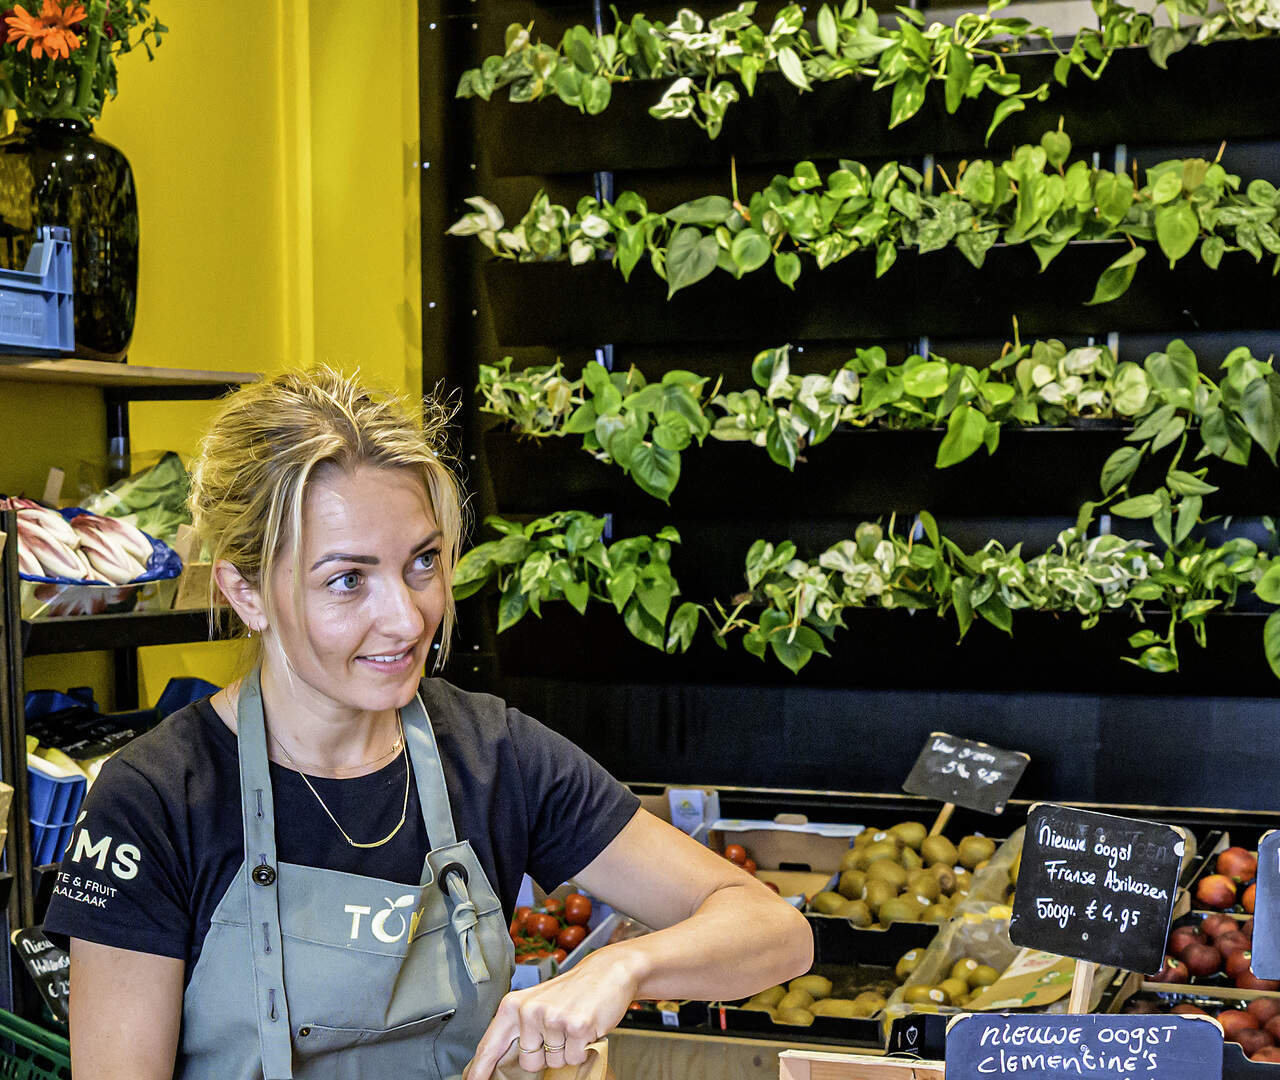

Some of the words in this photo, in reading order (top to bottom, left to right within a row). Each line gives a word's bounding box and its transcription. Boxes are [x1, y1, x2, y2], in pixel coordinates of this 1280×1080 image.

[65, 828, 141, 880] MS
[1038, 825, 1086, 851] Nieuwe
[1094, 843, 1132, 869] oogst
[53, 885, 108, 908] AALZAAK
[72, 877, 81, 887] &
[85, 880, 117, 898] FRUIT
[1044, 860, 1096, 886] Franse
[1104, 869, 1168, 902] Abrikozen
